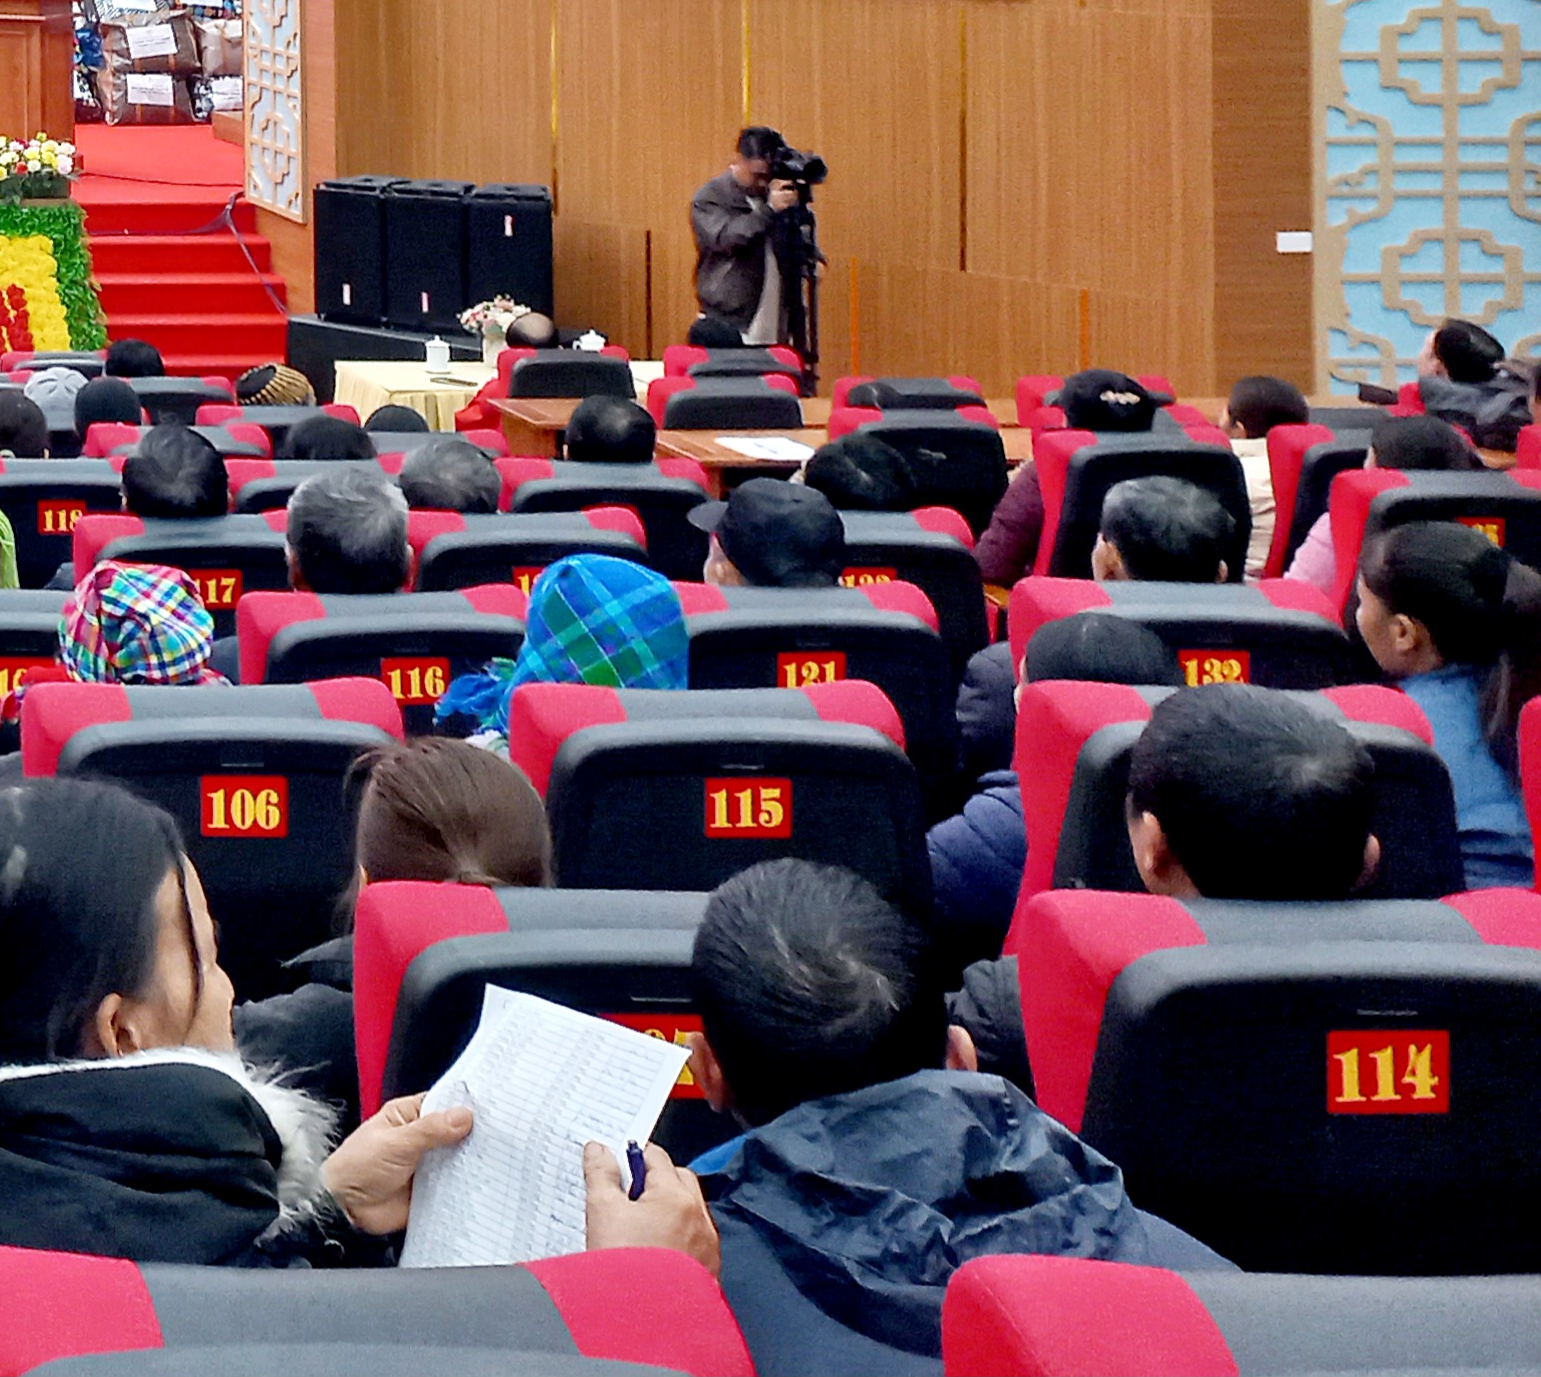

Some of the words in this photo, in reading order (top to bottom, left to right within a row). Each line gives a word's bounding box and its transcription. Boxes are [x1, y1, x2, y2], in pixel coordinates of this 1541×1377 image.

[389, 666, 445, 699] 116
[208, 788, 281, 830] 106
[712, 788, 784, 828] 115
[1335, 1044, 1439, 1102] 114
